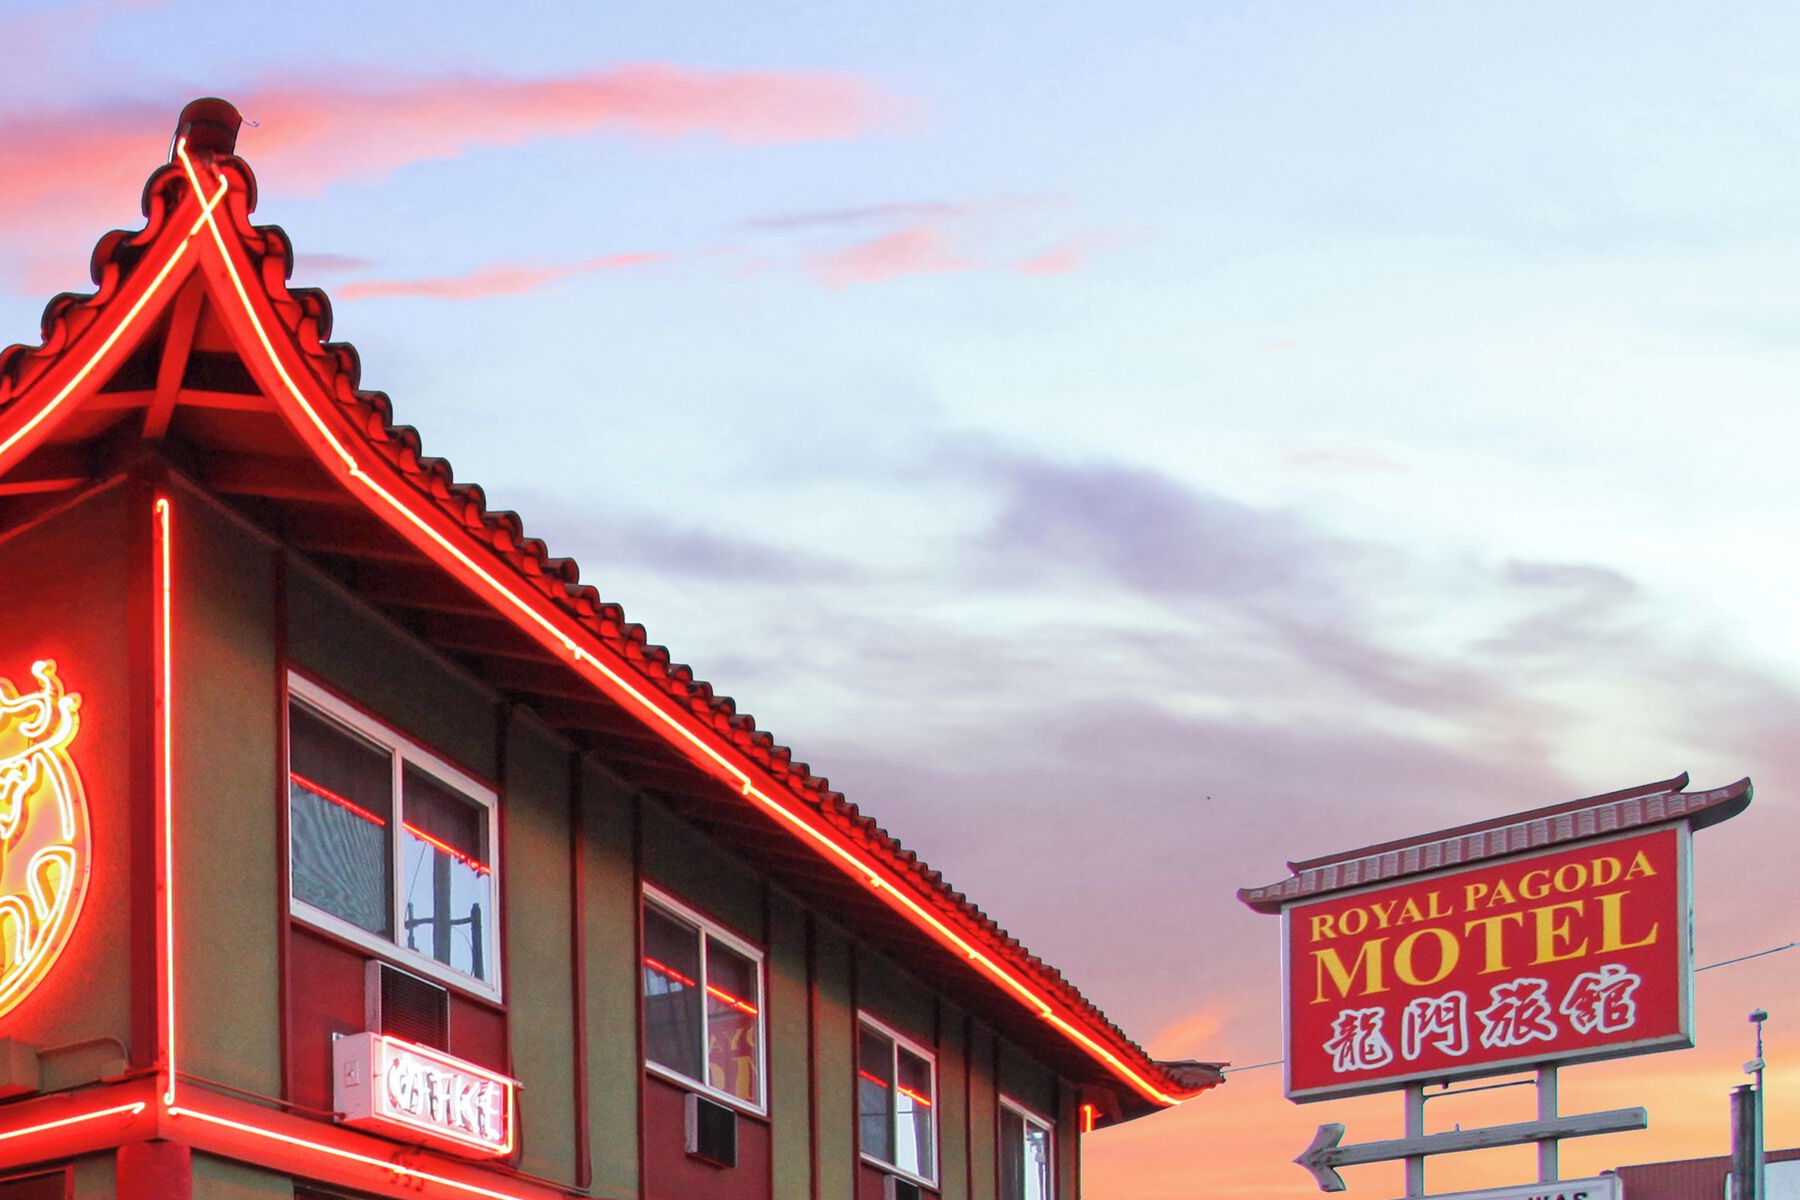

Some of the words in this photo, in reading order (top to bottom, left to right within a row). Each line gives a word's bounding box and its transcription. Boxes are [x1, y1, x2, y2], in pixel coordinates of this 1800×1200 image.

[1309, 890, 1659, 1005] MOTEL
[1310, 890, 1453, 943] ROYAL
[1464, 849, 1658, 913] PAGODA
